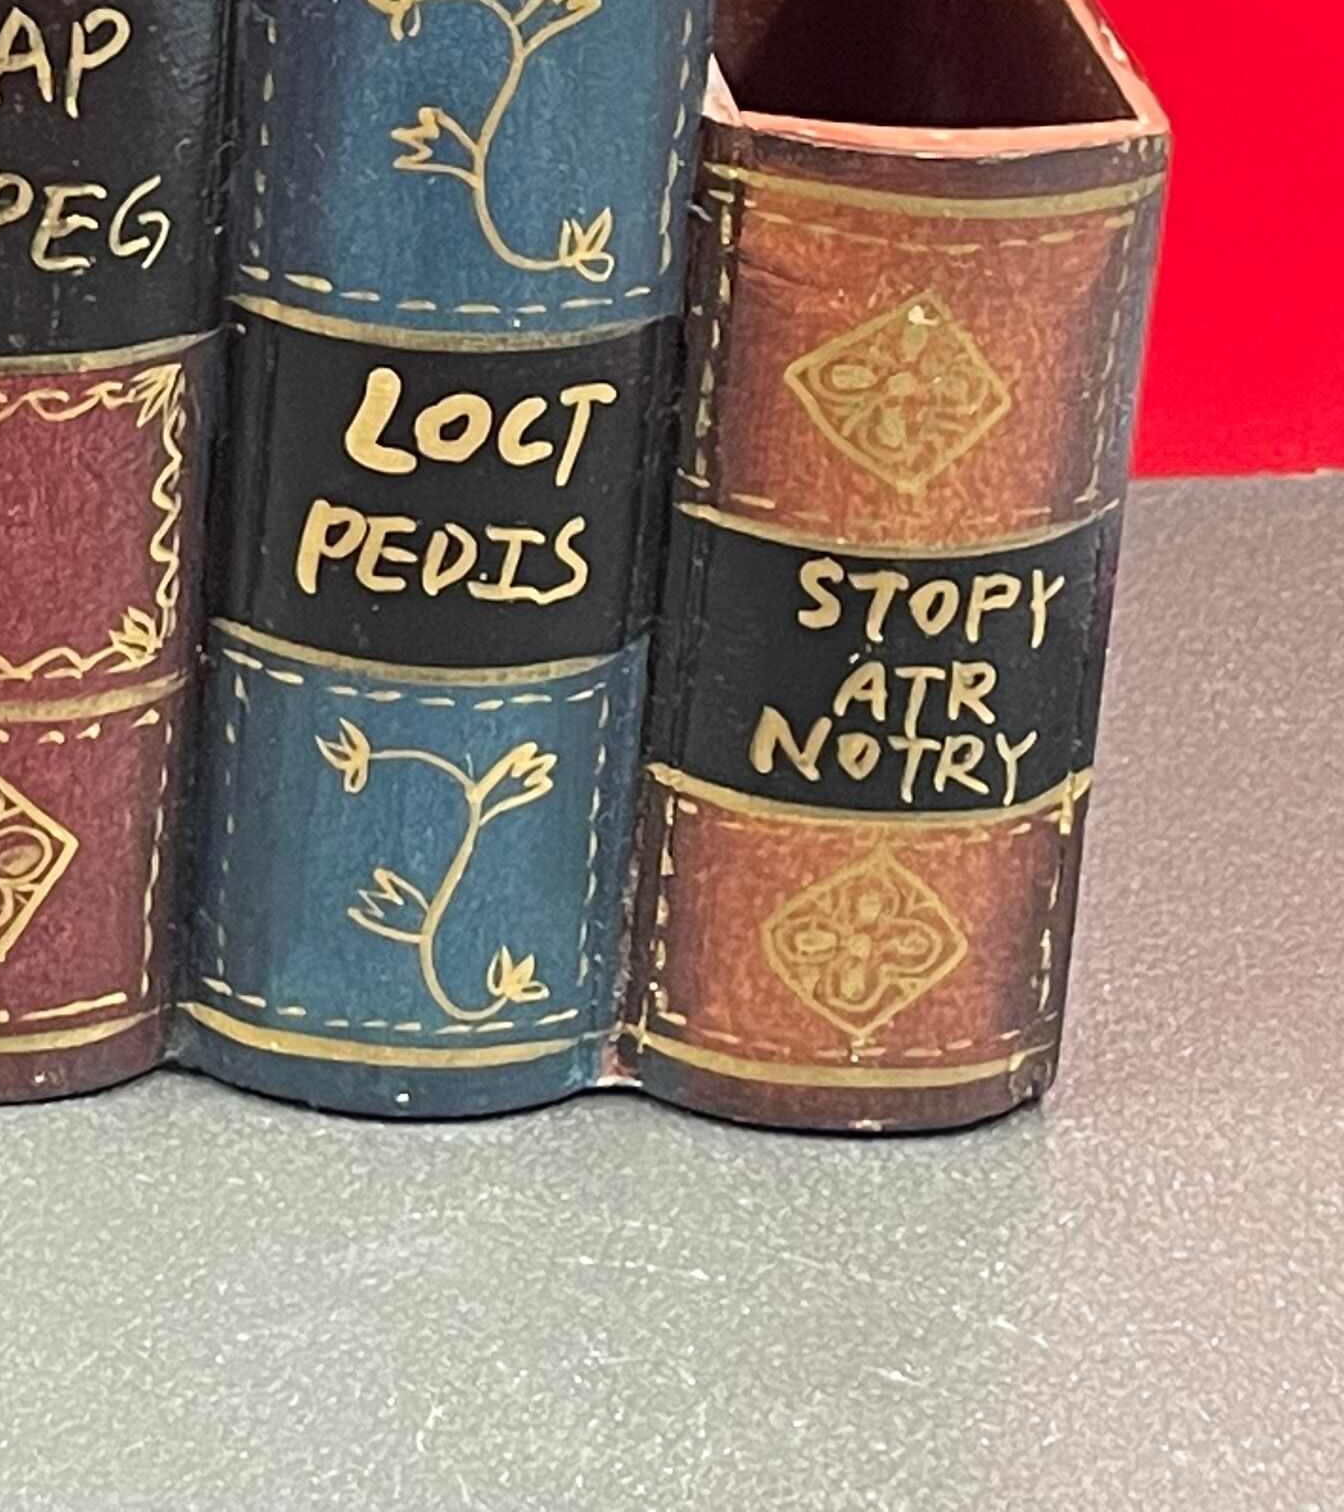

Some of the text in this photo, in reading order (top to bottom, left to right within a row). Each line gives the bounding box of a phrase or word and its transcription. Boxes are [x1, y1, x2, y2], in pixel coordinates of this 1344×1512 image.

[344, 366, 618, 487] LOCT
[295, 498, 589, 605] PEDIS
[796, 556, 1065, 649] STOPY
[832, 660, 996, 738] ATR
[749, 705, 1038, 806] NOTRY
